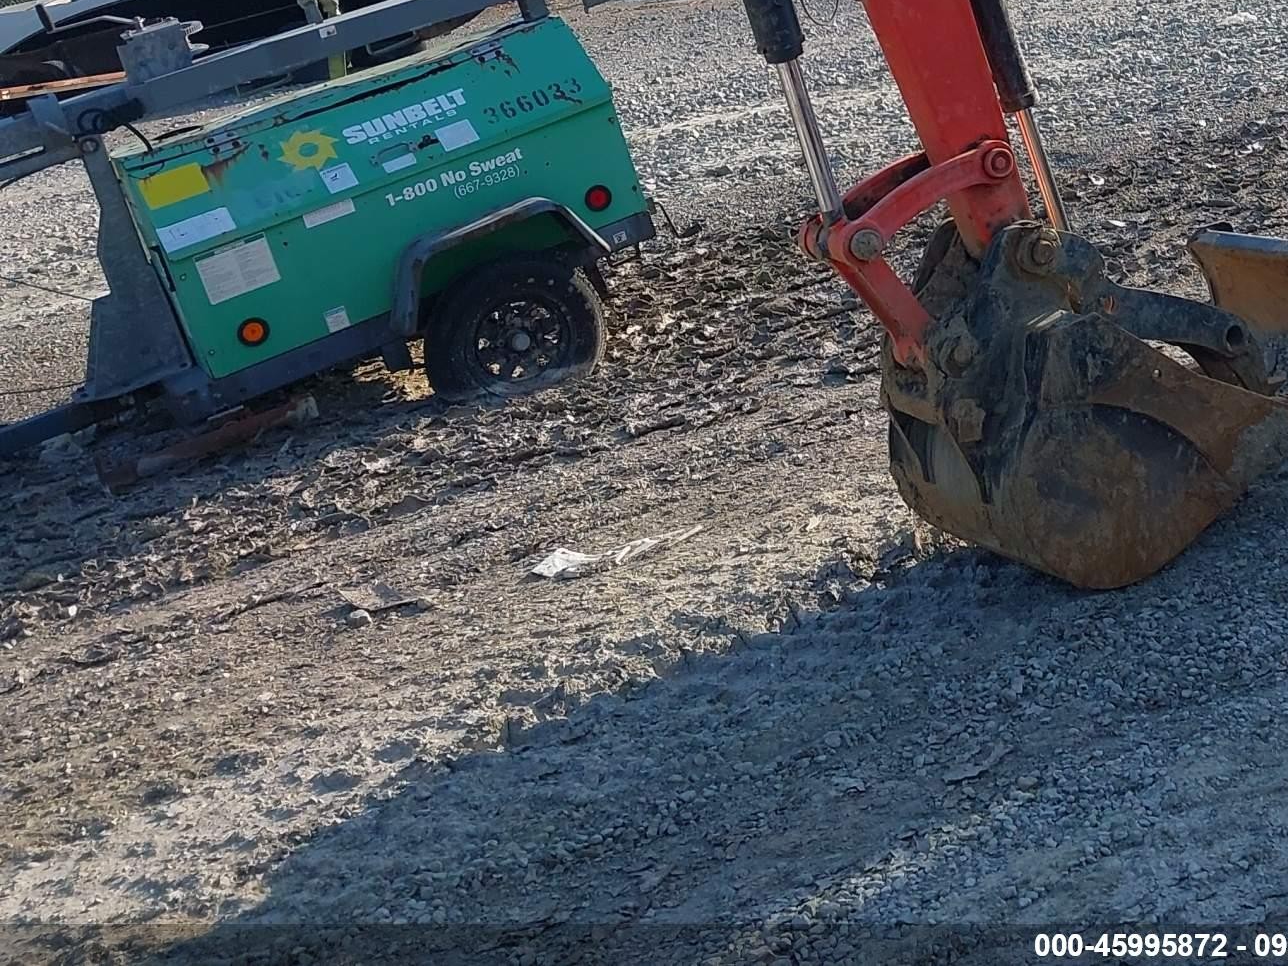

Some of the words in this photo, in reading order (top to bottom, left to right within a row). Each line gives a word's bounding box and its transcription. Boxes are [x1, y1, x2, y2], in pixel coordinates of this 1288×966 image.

[342, 88, 467, 145] SUNBELT
[483, 77, 583, 125] 366033
[368, 109, 457, 145] RENTALS
[385, 178, 438, 207] 1-800
[440, 169, 466, 187] No
[468, 146, 524, 177] Sweat
[453, 164, 521, 199] (667-9328)
